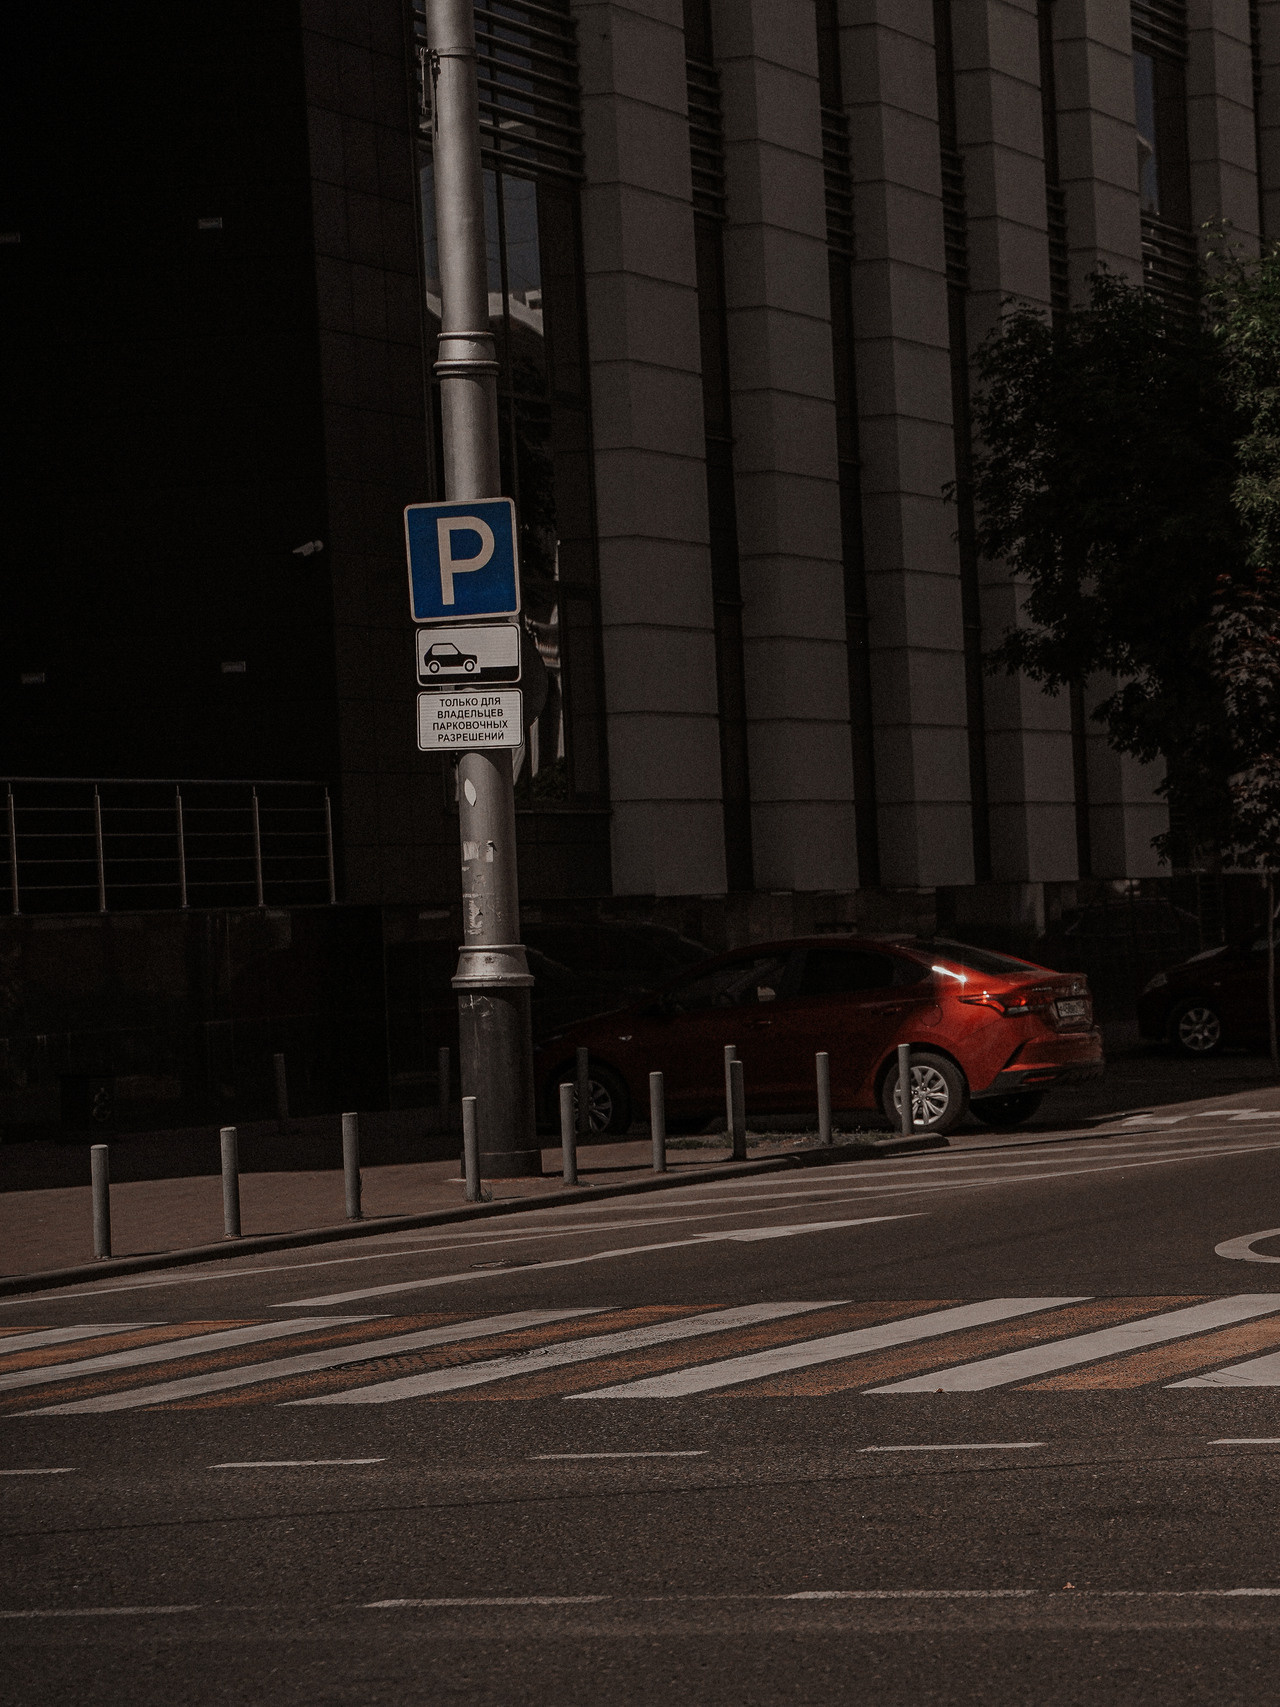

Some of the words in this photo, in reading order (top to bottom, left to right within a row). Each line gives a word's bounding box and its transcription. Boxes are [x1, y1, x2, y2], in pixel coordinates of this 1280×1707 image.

[436, 515, 495, 606] P
[440, 697, 479, 707] ТОЛЬКО
[480, 697, 501, 707] ДЛЯ
[437, 709, 504, 719] ВЛАДЕЛЬЦЕВ
[432, 720, 508, 731] ПАРКОВОЧНЫХ
[437, 730, 504, 742] РАЗРЕШЕНИЙ
